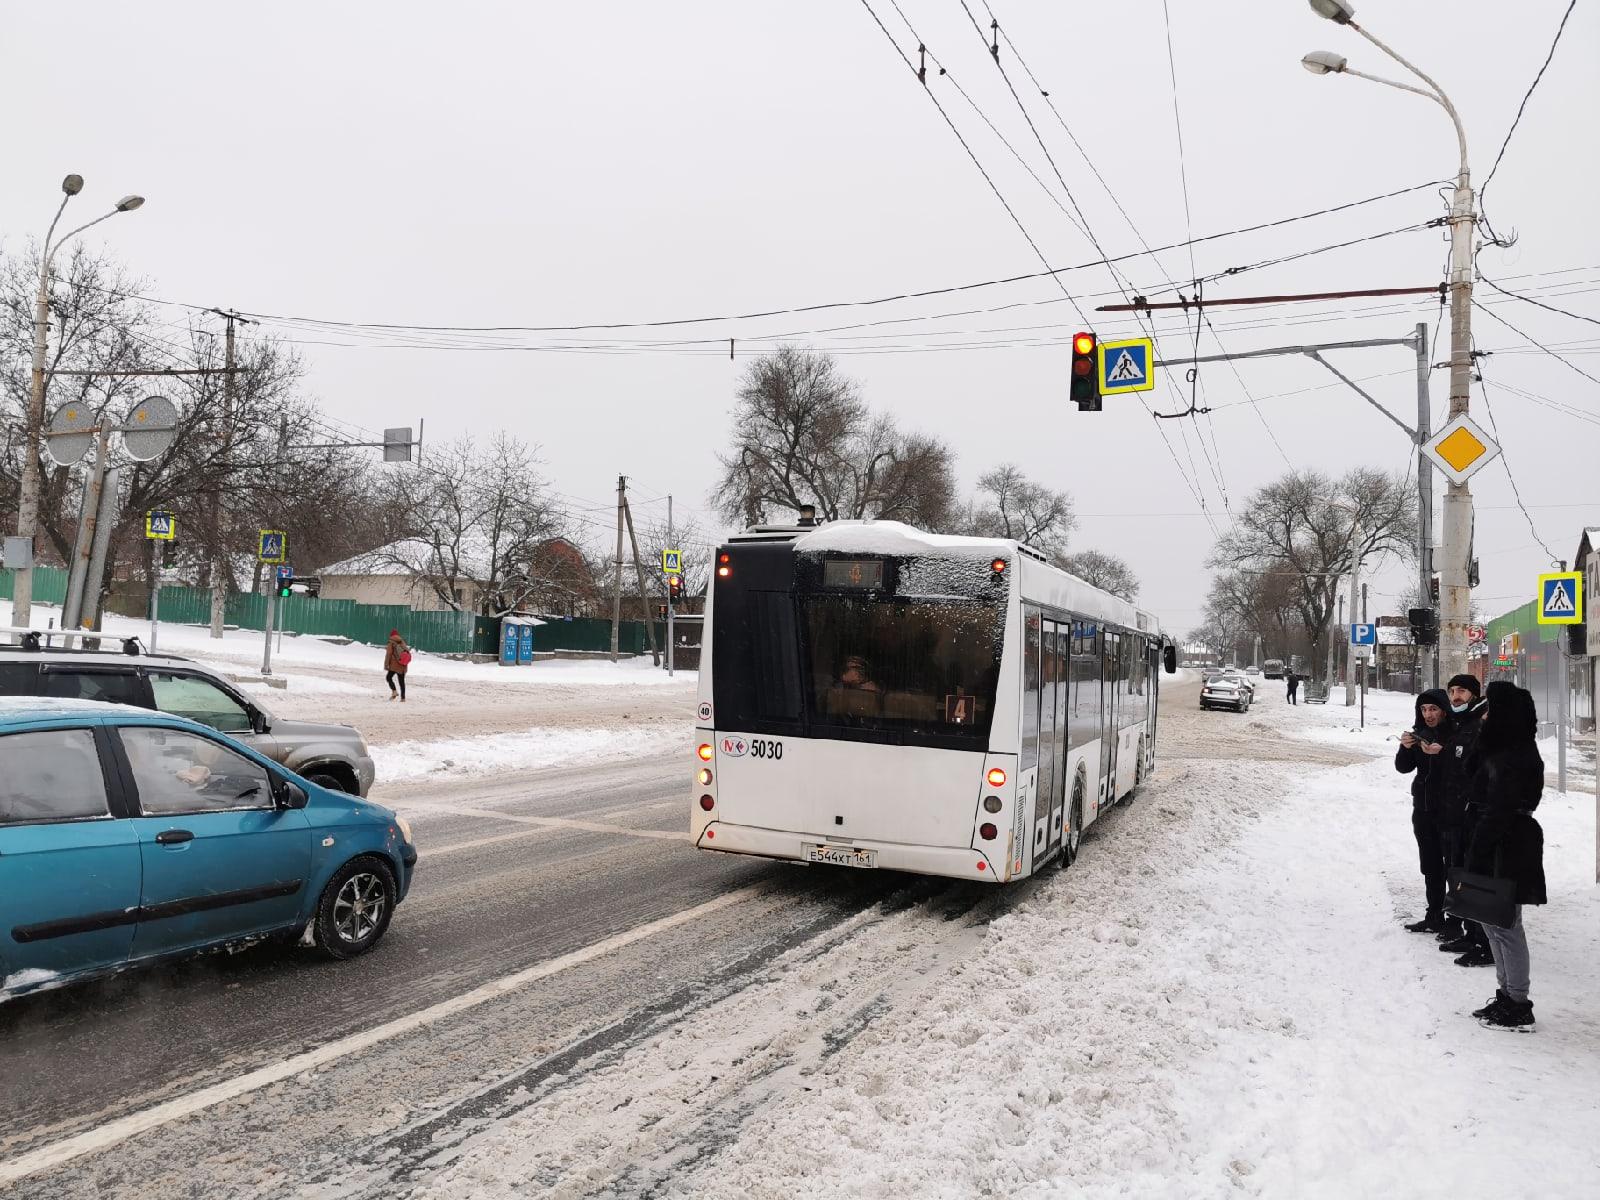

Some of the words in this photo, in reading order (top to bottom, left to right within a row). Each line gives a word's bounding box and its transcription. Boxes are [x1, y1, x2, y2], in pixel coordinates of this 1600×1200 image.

[700, 707, 710, 716] 40
[954, 699, 966, 720] 4
[751, 740, 783, 760] 5030
